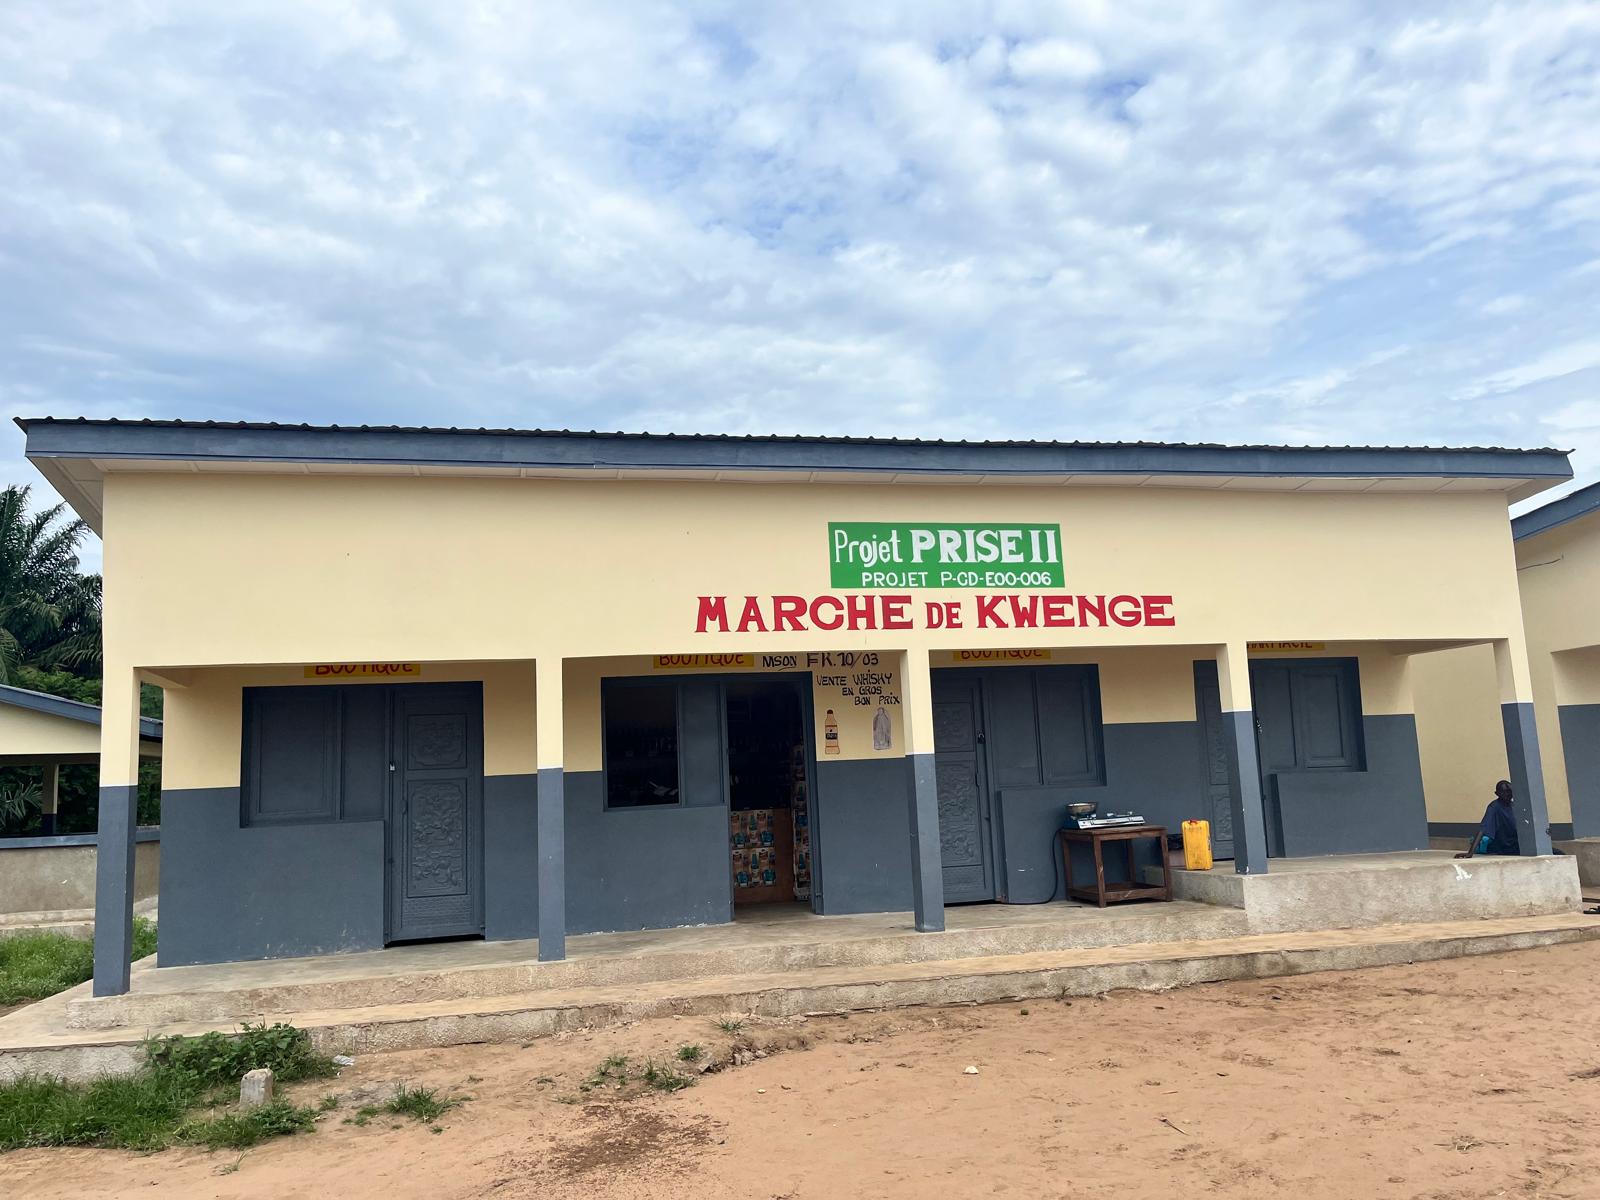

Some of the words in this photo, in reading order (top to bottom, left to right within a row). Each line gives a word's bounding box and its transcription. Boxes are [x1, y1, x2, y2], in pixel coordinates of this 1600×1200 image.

[834, 529, 903, 568] Projet
[861, 571, 928, 587] PROJET
[694, 595, 914, 633] MARCHE
[924, 602, 963, 629] DE
[975, 595, 1176, 629] KWENGE
[659, 653, 745, 667] BOUTIQUE
[816, 674, 847, 686] VENTE
[842, 687, 854, 696] EN
[859, 685, 882, 696] GROS
[854, 695, 871, 706] BON
